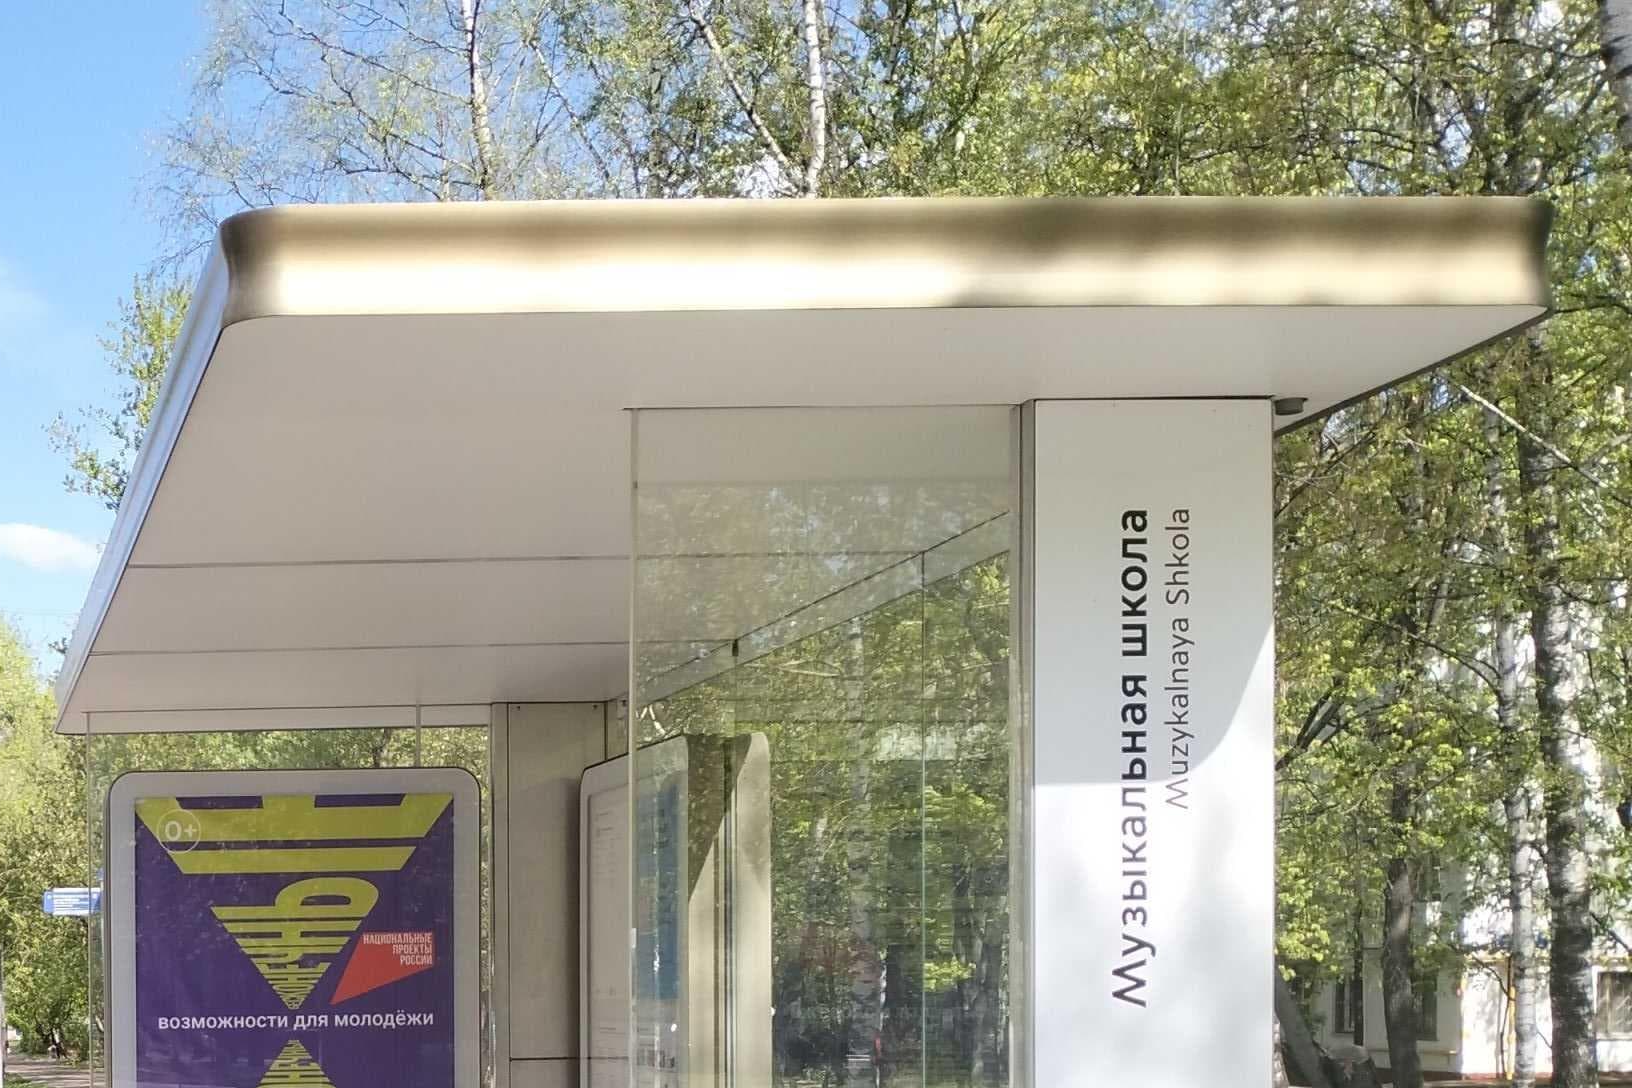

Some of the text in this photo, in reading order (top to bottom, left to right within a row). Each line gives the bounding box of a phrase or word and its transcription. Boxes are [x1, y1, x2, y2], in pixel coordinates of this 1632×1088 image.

[1164, 508, 1196, 811] Muzykalnaya Shkola
[1111, 509, 1156, 1008] Музыкальная школа
[165, 820, 198, 841] 0+
[363, 932, 433, 945] НАЦИОНАЛЬНЫЕ
[392, 943, 433, 955] ПРОЕКТЫ
[400, 954, 433, 966] РОССИИ
[158, 1010, 435, 1031] возможности для молодёжи
